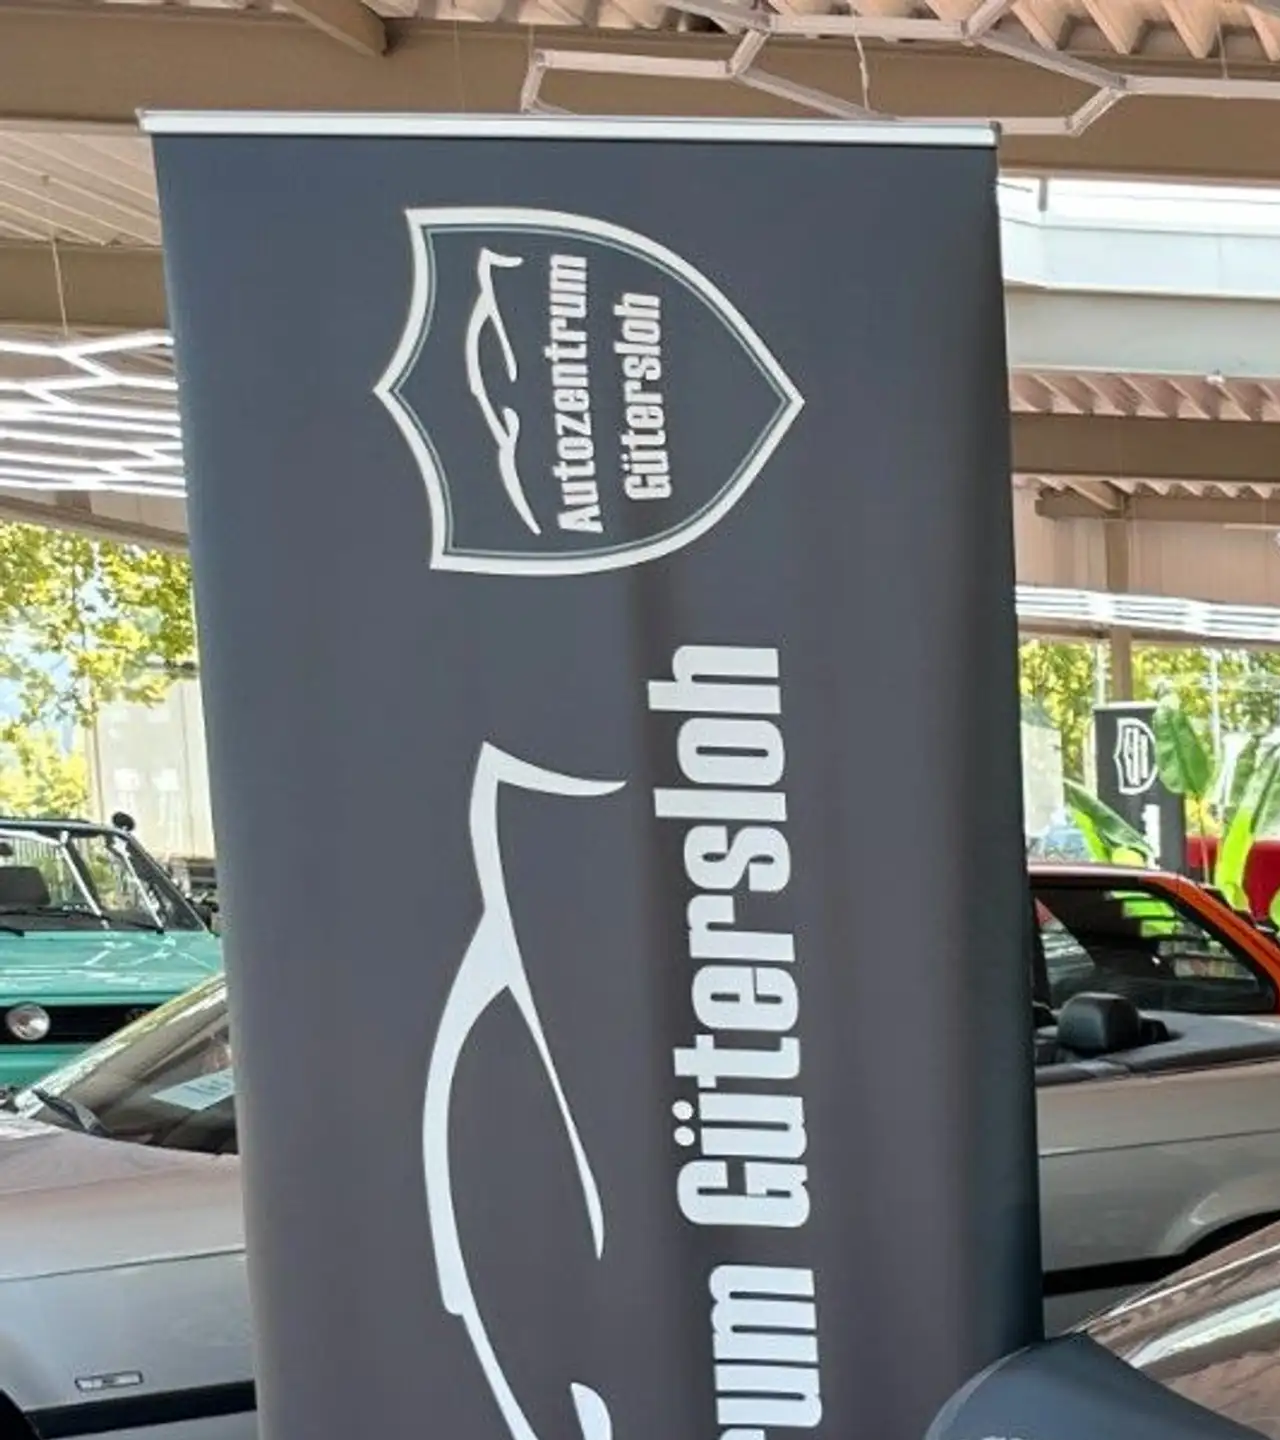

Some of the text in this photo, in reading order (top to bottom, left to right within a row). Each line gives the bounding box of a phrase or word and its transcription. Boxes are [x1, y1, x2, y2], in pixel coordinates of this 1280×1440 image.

[544, 253, 604, 533] Autozentrum
[613, 291, 672, 501] Gütersloh
[647, 644, 811, 1229] Gütersloh
